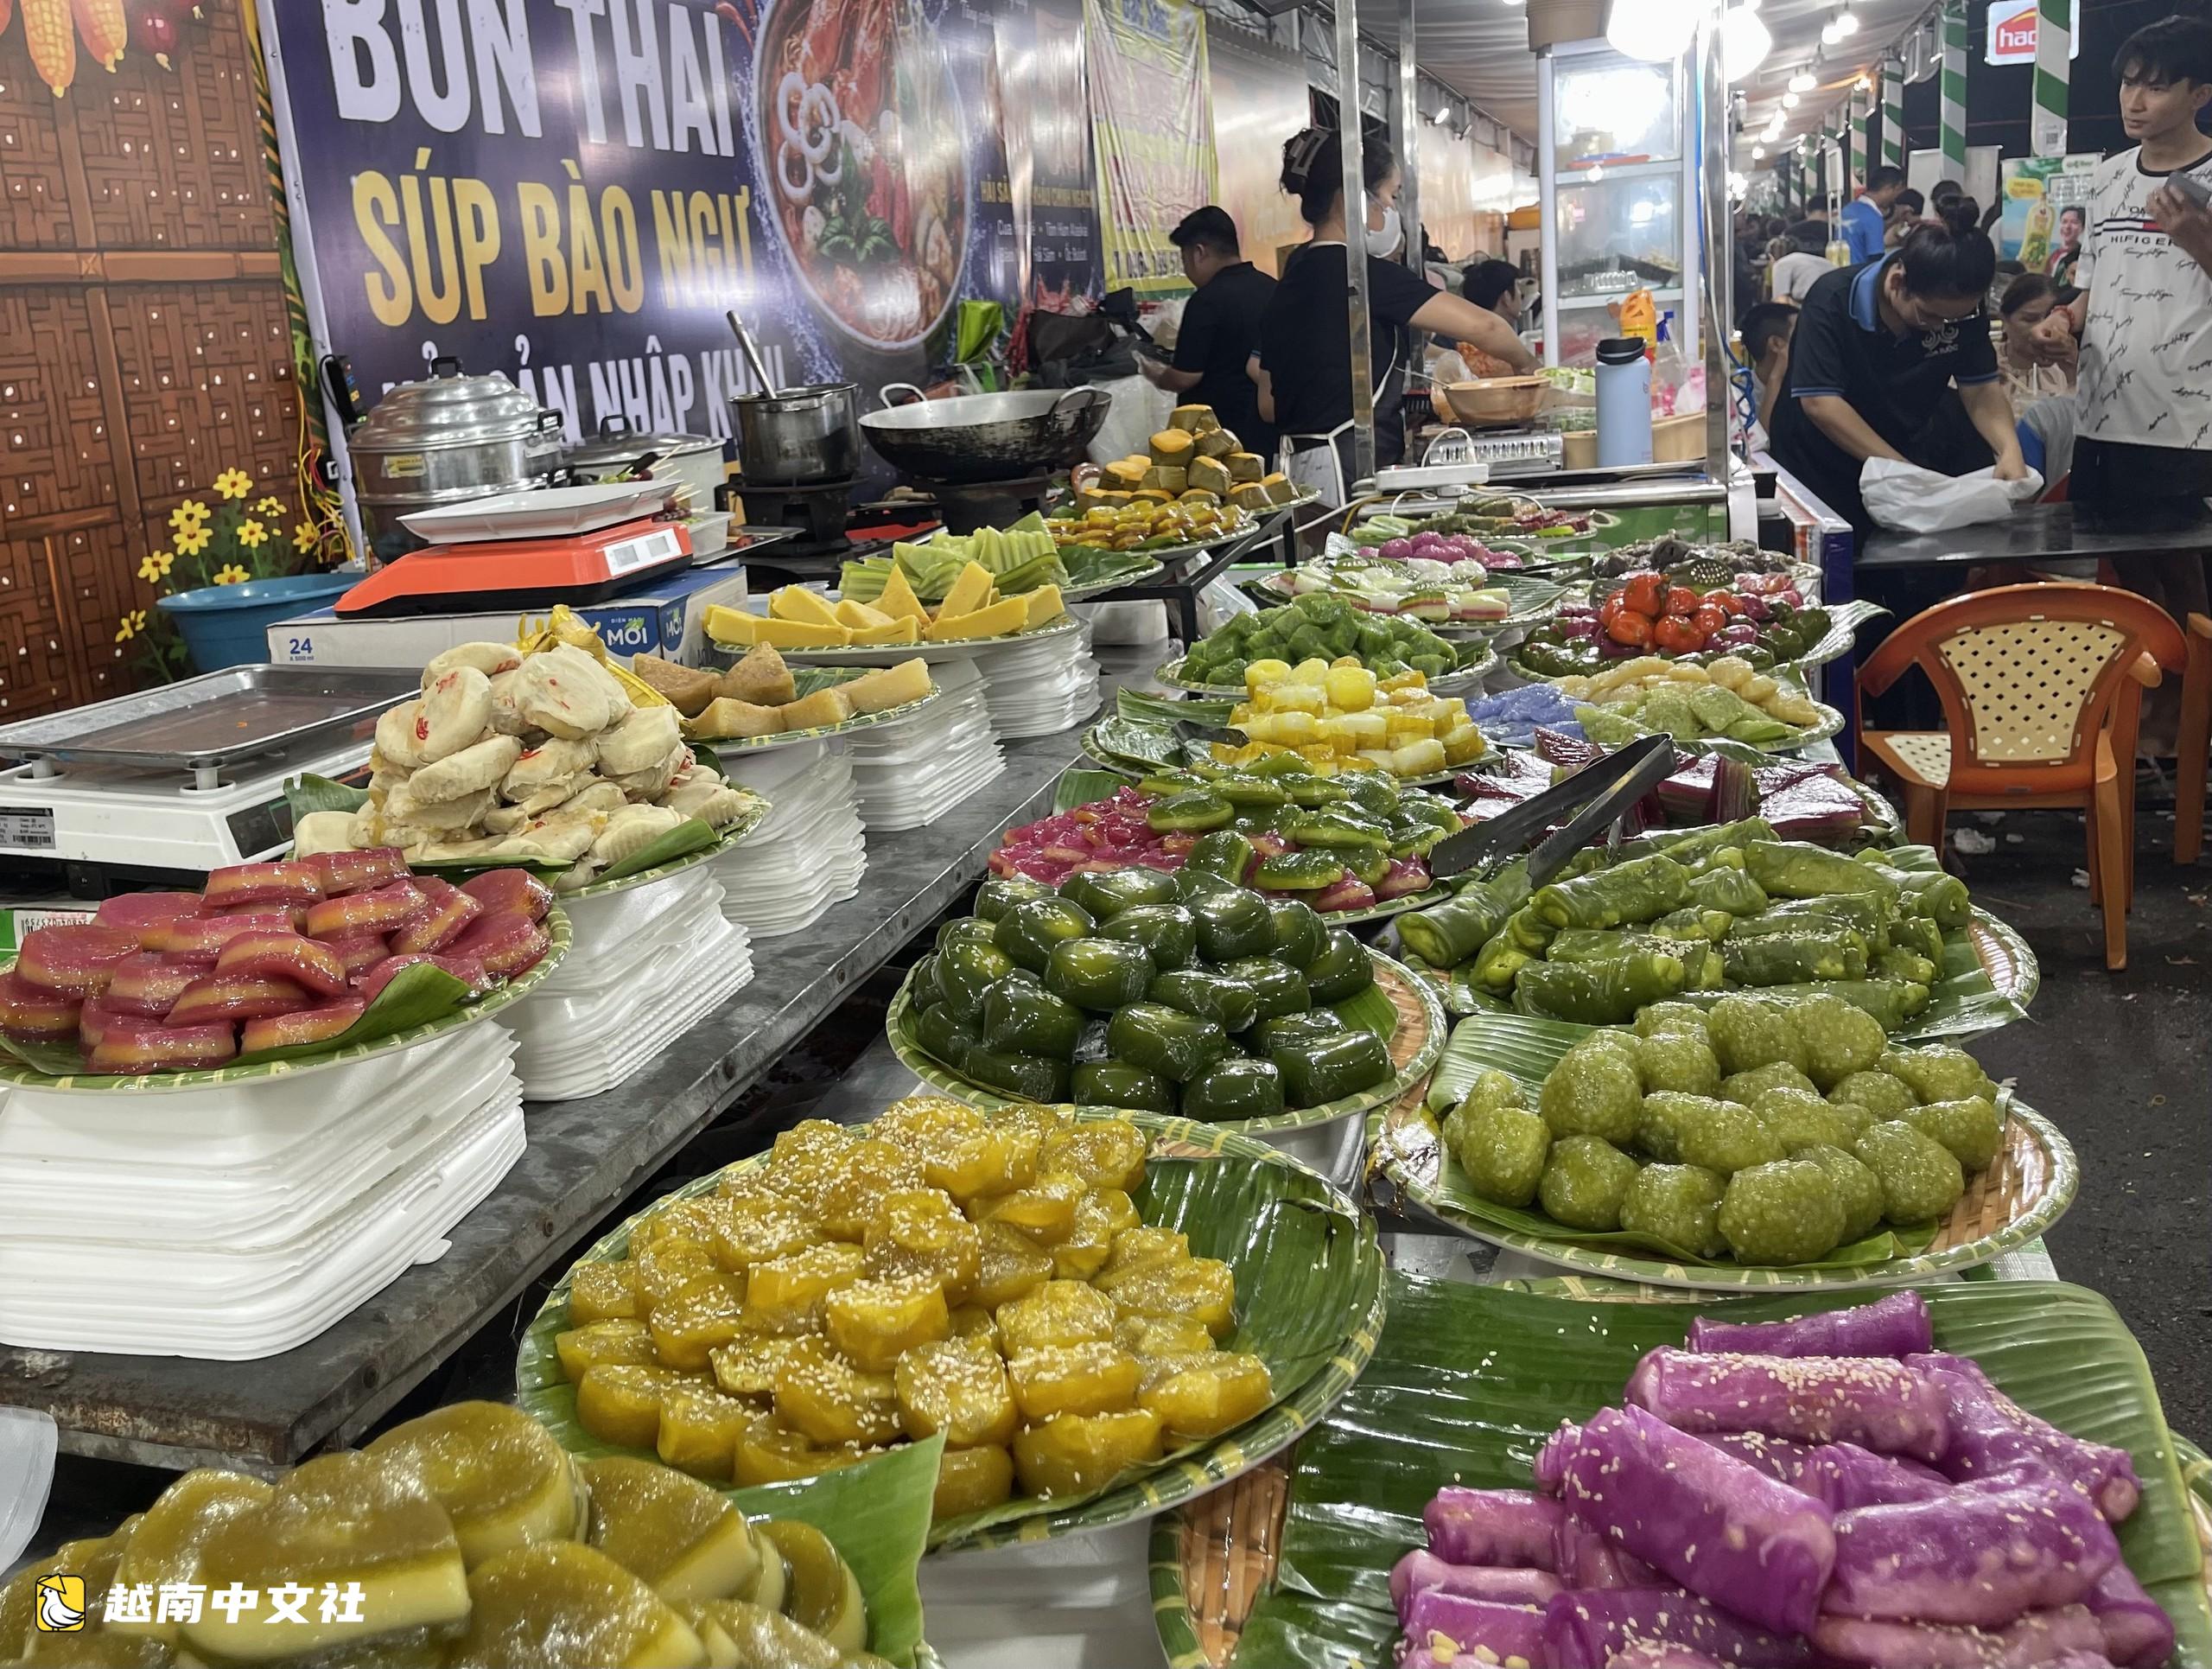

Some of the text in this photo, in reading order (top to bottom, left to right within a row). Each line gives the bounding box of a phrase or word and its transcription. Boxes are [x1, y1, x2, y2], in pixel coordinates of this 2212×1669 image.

[352, 147, 755, 327] SÚP BÀO NGƯ
[493, 334, 582, 443] ẢN
[289, 637, 312, 653] 24
